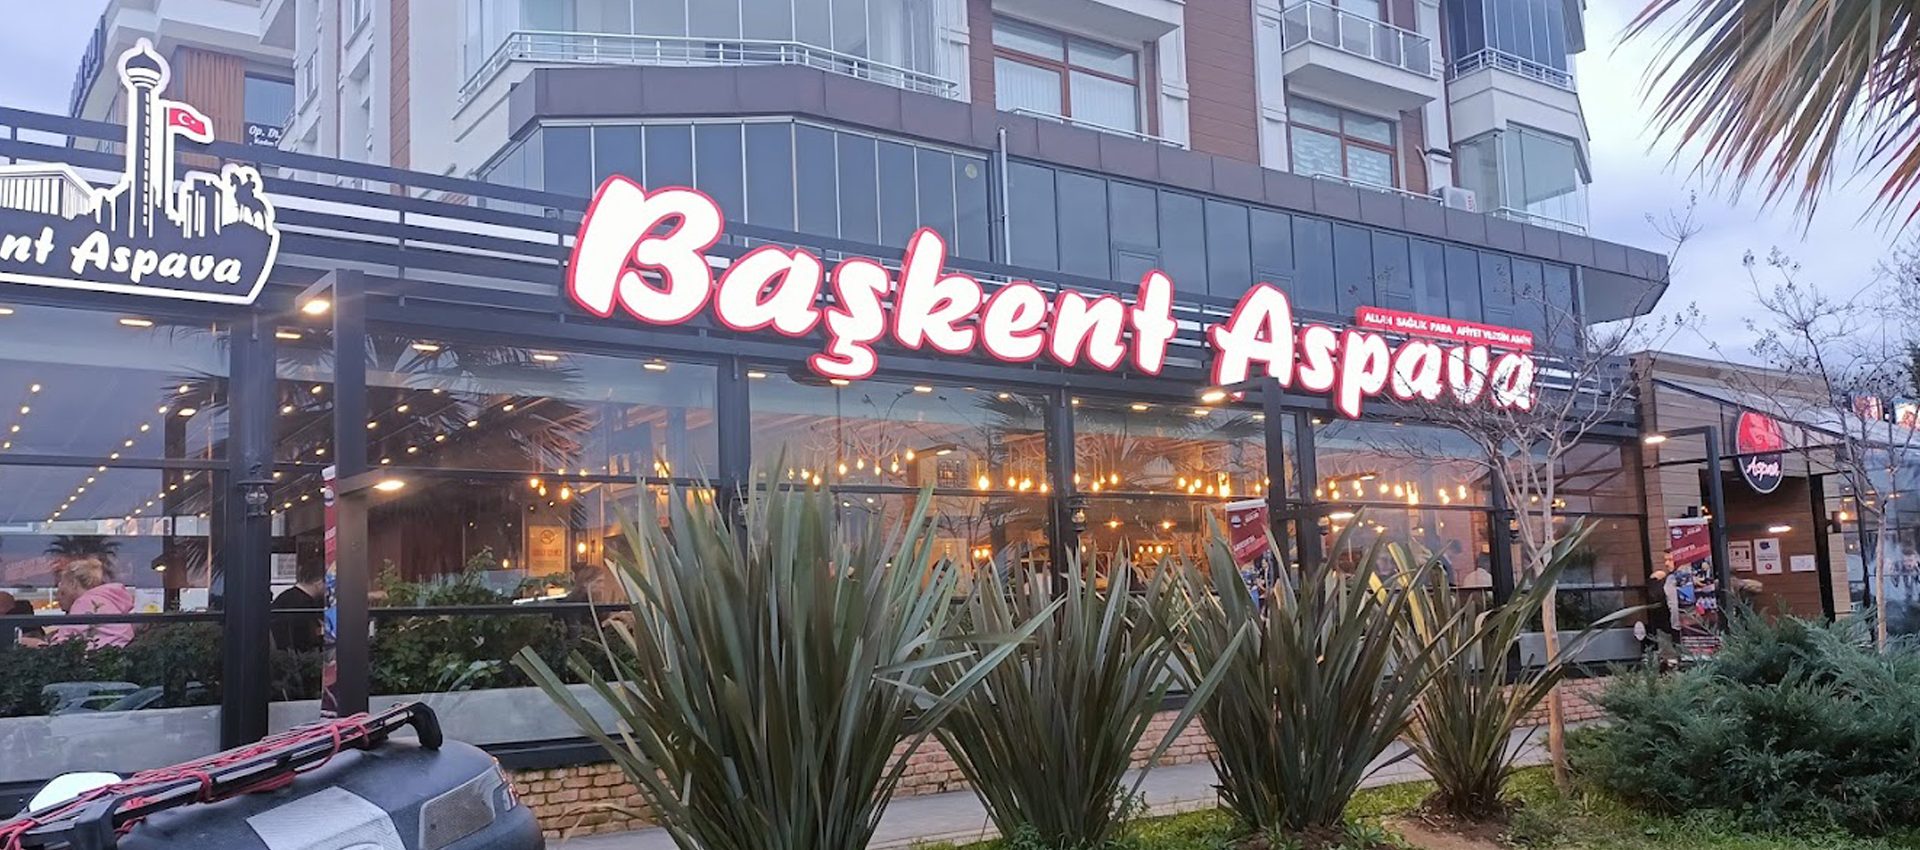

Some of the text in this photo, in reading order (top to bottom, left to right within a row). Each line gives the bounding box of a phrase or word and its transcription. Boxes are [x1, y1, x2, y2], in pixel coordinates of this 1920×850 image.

[71, 230, 242, 284] Aspava
[565, 173, 1536, 420] Başkent Aspava
